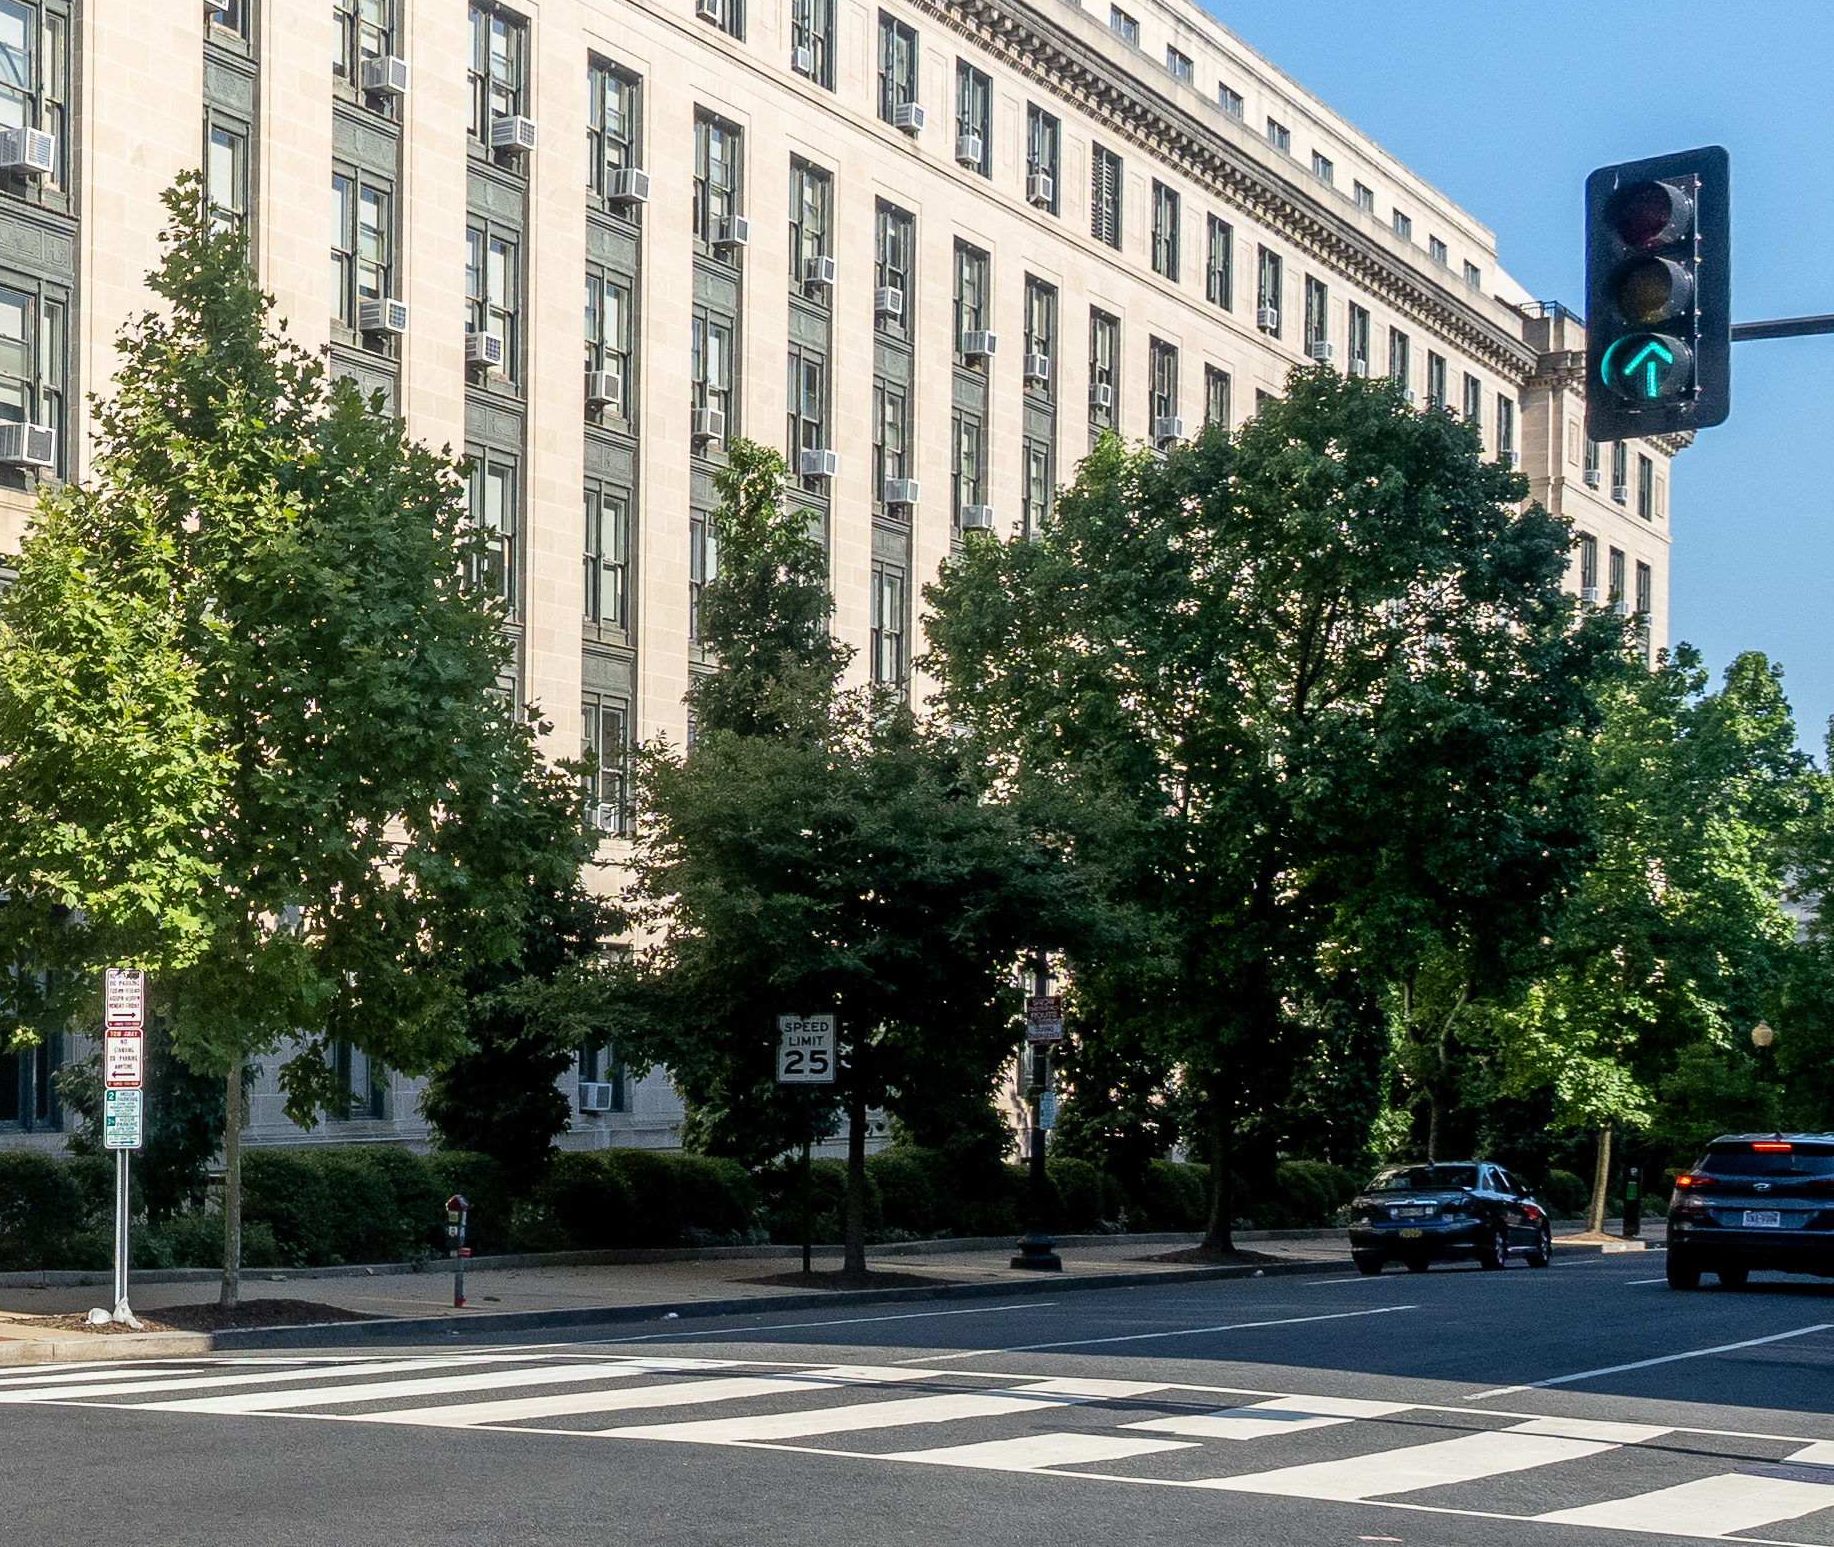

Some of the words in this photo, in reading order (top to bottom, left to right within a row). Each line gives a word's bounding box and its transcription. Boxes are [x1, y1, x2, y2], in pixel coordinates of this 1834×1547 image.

[784, 1021, 829, 1032] SPEED
[788, 1035, 825, 1047] LIMIT
[783, 1049, 829, 1074] 25
[107, 1091, 115, 1100] 2
